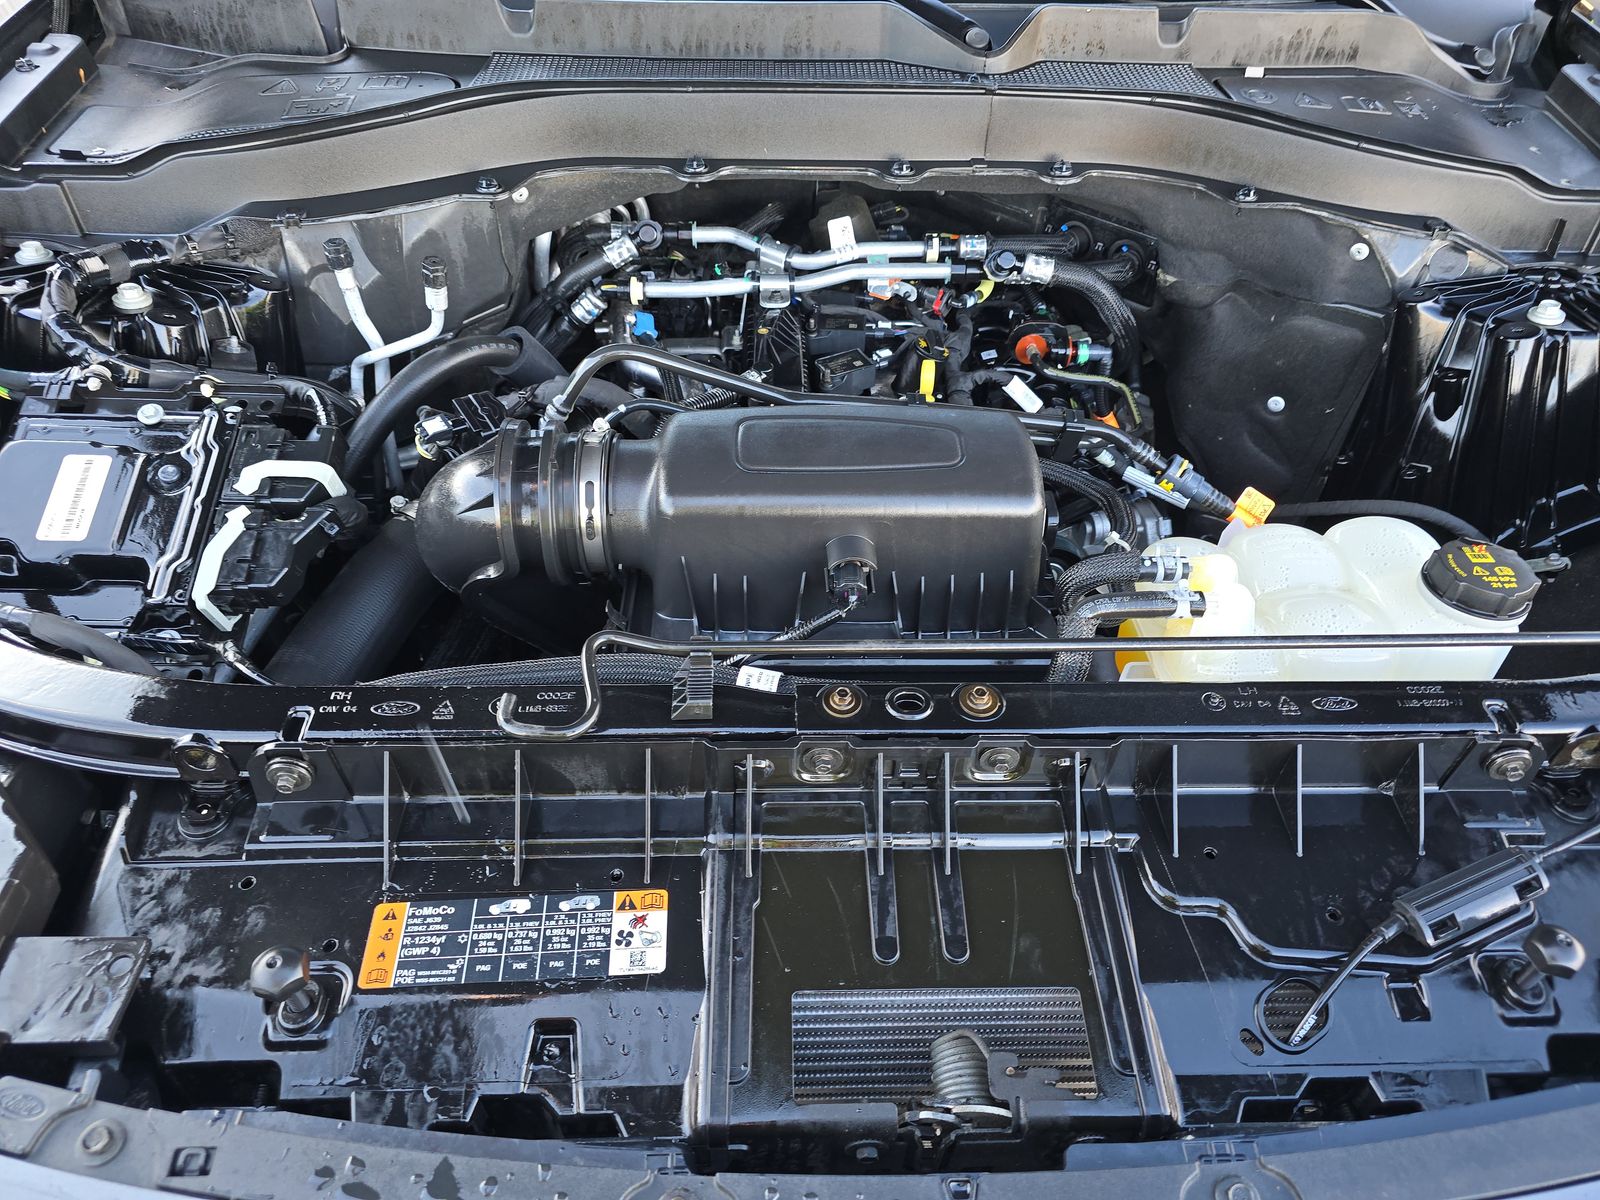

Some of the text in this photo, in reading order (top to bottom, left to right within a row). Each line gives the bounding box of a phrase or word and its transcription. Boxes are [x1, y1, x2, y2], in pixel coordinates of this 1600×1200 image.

[330, 691, 352, 700] RH
[1238, 687, 1259, 696] LH
[408, 905, 455, 916] FoMoCo
[581, 927, 611, 935] 0.992 kg
[493, 932, 503, 940] kg
[403, 935, 447, 946] R-1234yf
[400, 947, 441, 958] (GWP 4)
[549, 960, 565, 968] PAG
[585, 958, 600, 966] POE
[475, 964, 491, 972] PAG
[396, 969, 416, 977] PAG
[395, 977, 415, 985] POE
